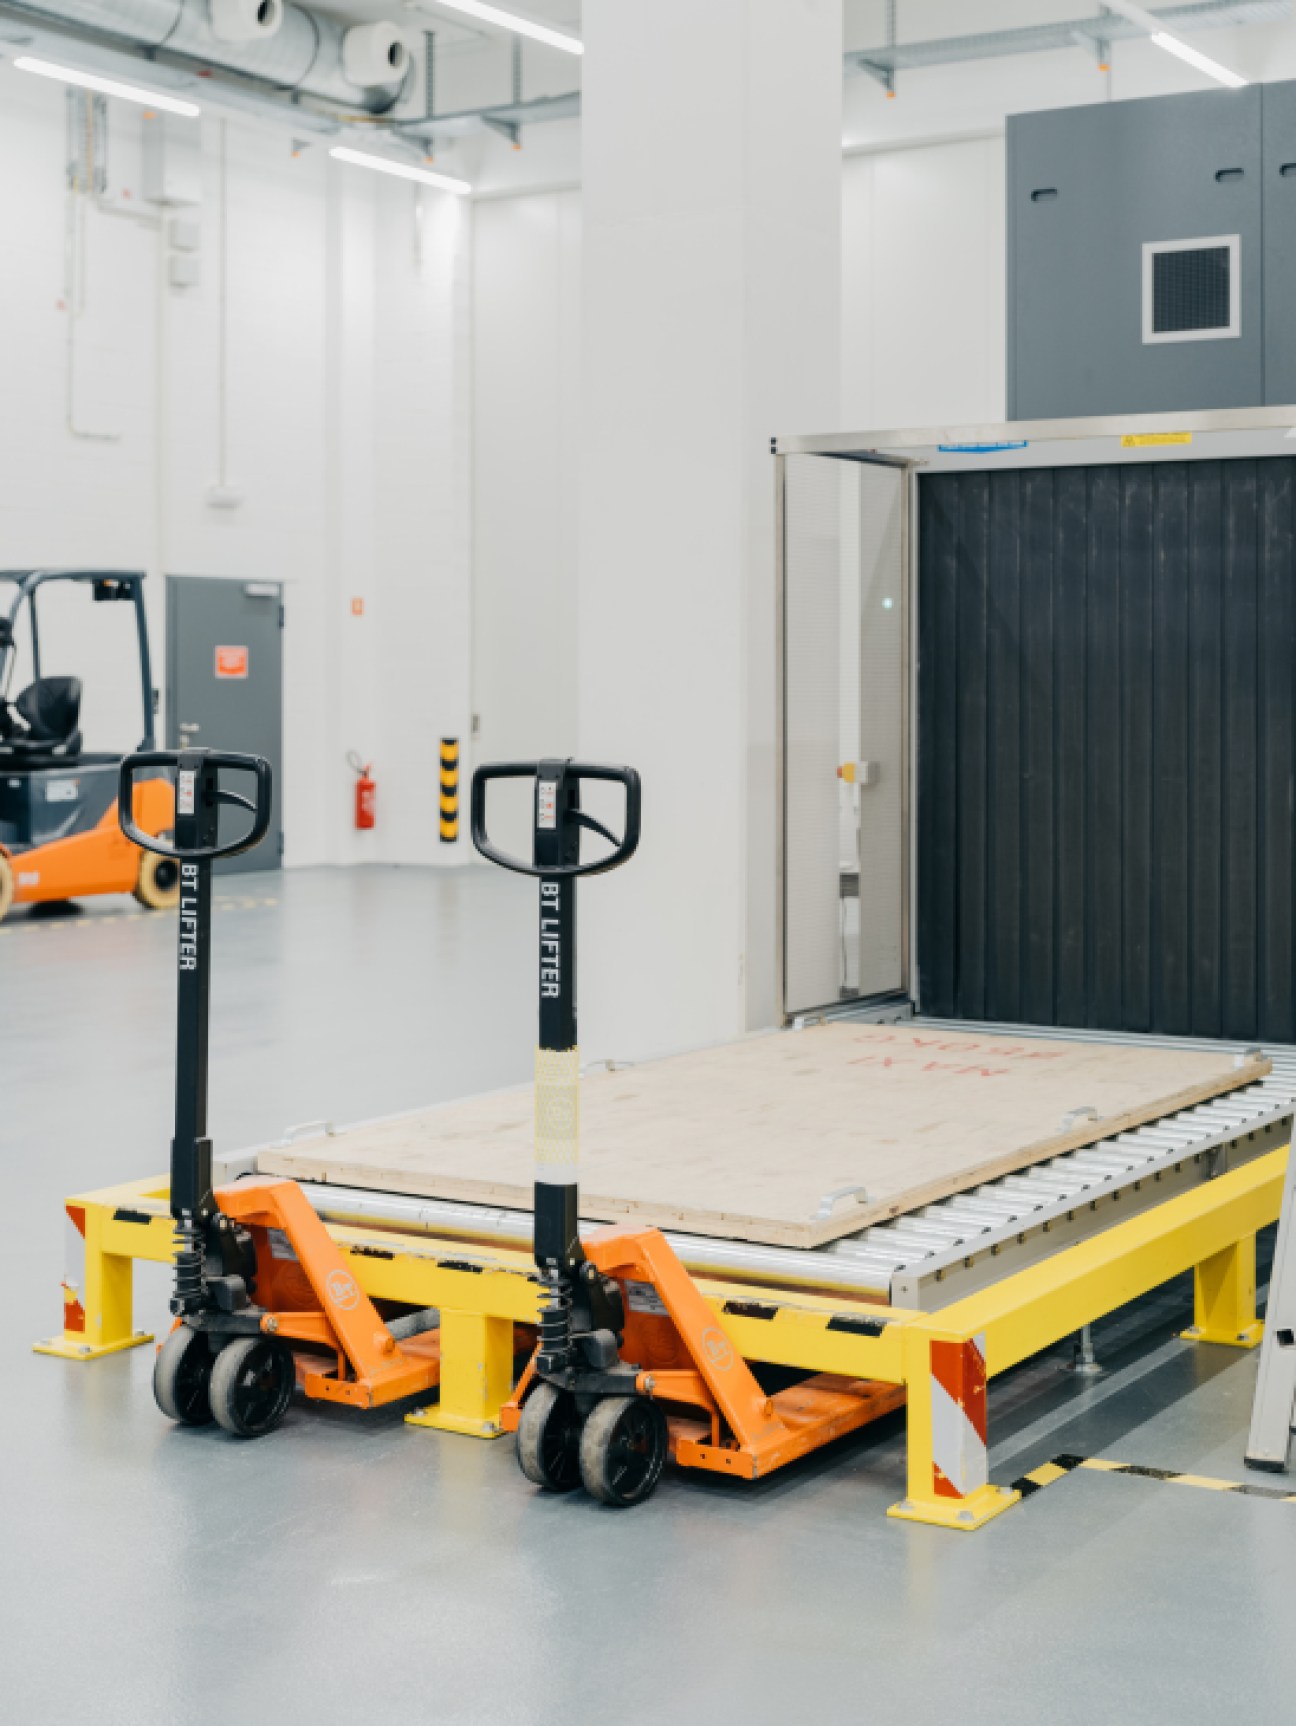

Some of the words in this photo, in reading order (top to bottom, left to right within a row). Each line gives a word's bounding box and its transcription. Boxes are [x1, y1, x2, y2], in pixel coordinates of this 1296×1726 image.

[181, 864, 198, 891] BT
[541, 882, 560, 911] BT
[180, 897, 198, 970] LIFTER
[541, 918, 560, 998] LIFTER
